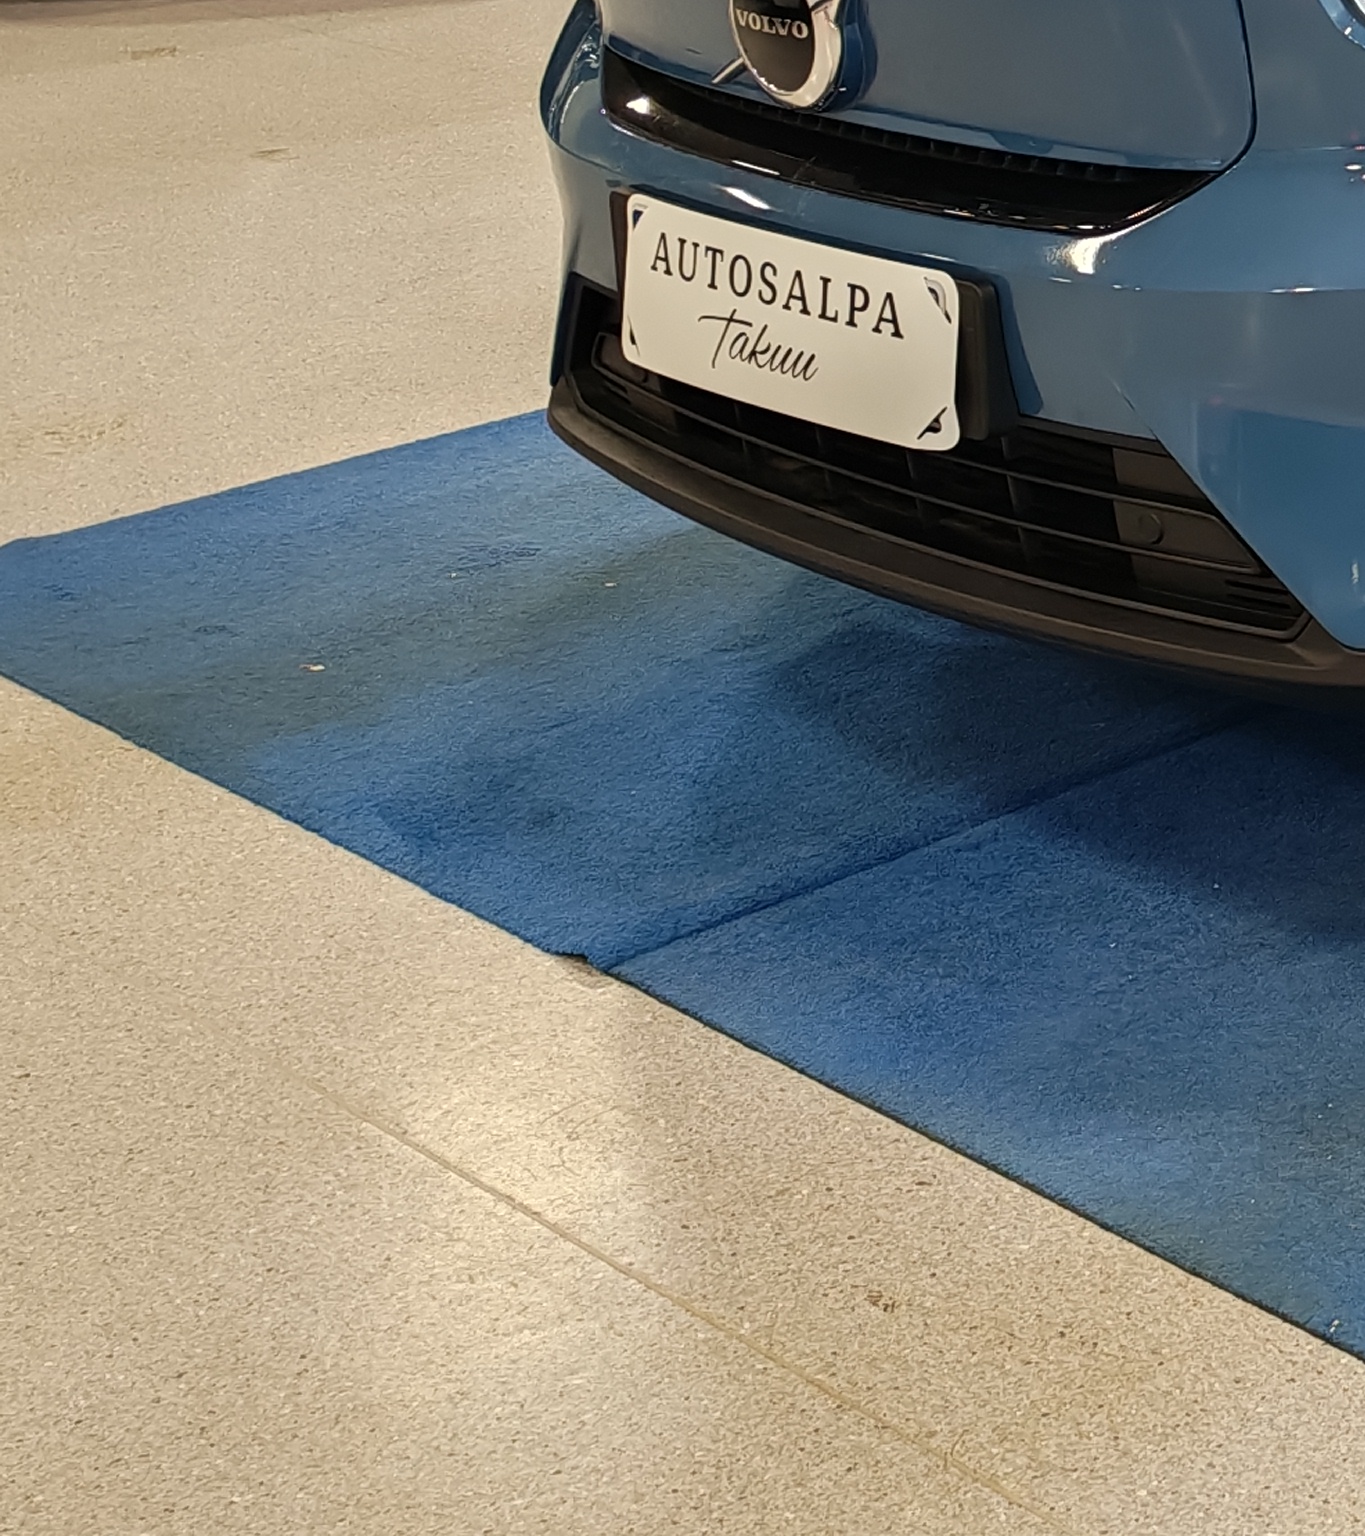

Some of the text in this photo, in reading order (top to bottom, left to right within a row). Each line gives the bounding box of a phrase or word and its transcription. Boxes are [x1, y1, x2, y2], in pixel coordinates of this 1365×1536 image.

[735, 9, 809, 40] VOLVO
[650, 231, 905, 339] AUTOSALPA
[698, 308, 820, 383] Takuu
